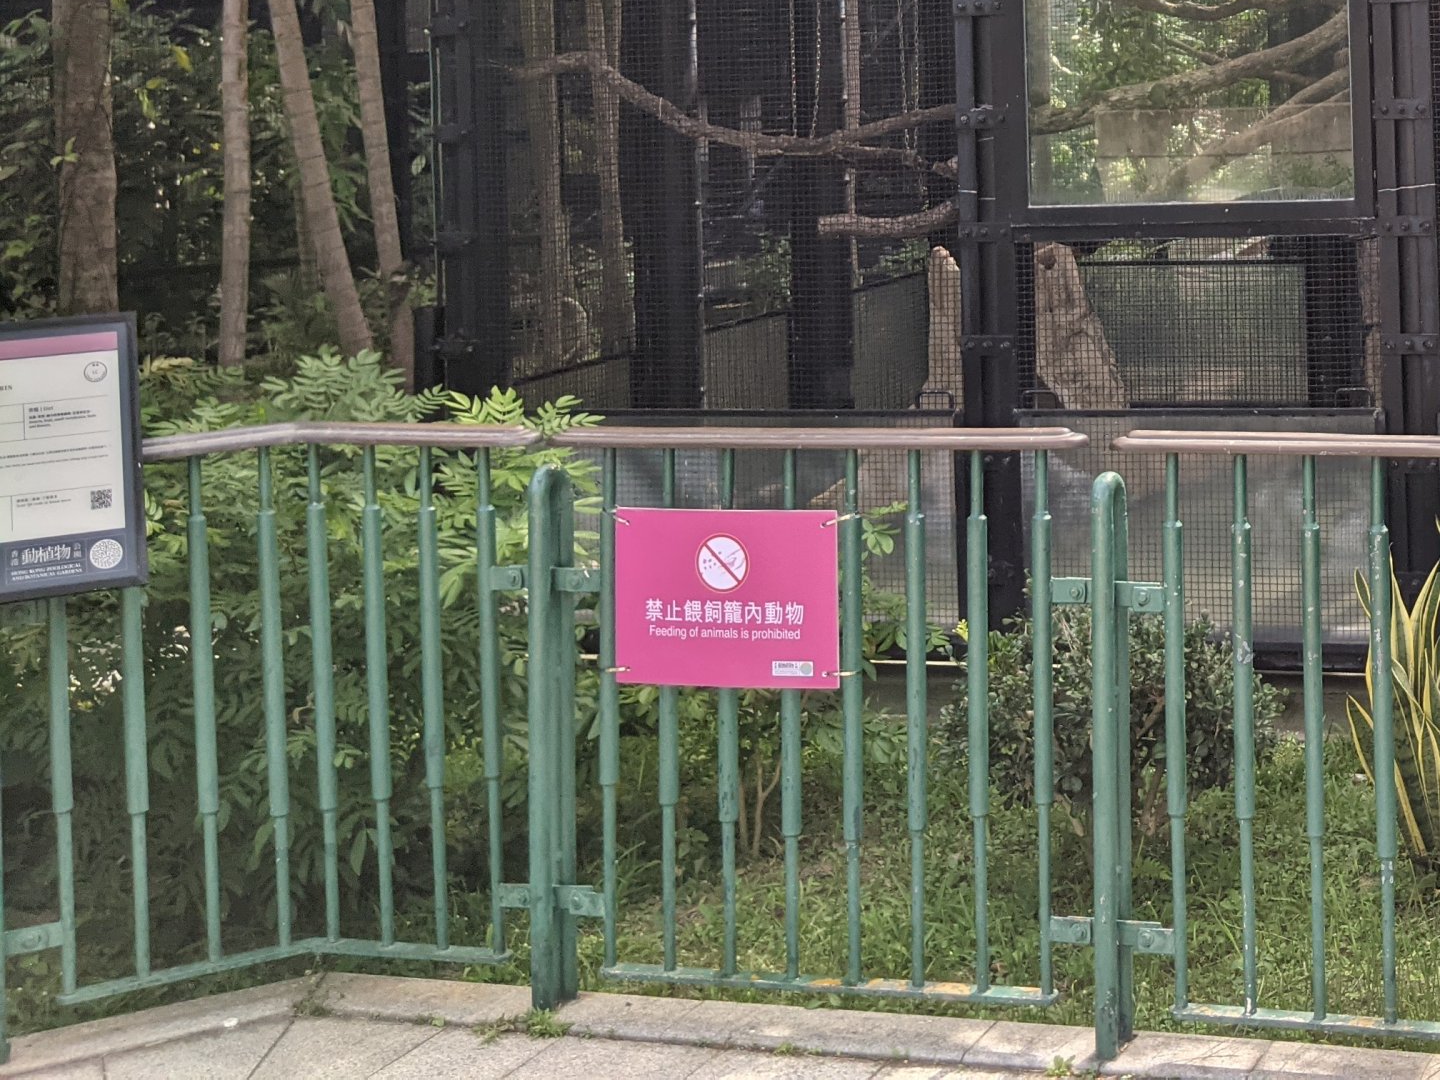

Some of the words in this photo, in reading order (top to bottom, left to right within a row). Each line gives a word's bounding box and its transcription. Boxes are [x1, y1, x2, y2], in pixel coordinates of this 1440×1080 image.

[56, 568, 83, 576] GARDENS
[645, 598, 804, 625] 禁止餵飼籠內動物
[649, 625, 687, 640] Feeding
[690, 626, 699, 638] of
[701, 627, 738, 639] animals
[741, 628, 749, 639] is
[751, 628, 801, 641] prohibited
